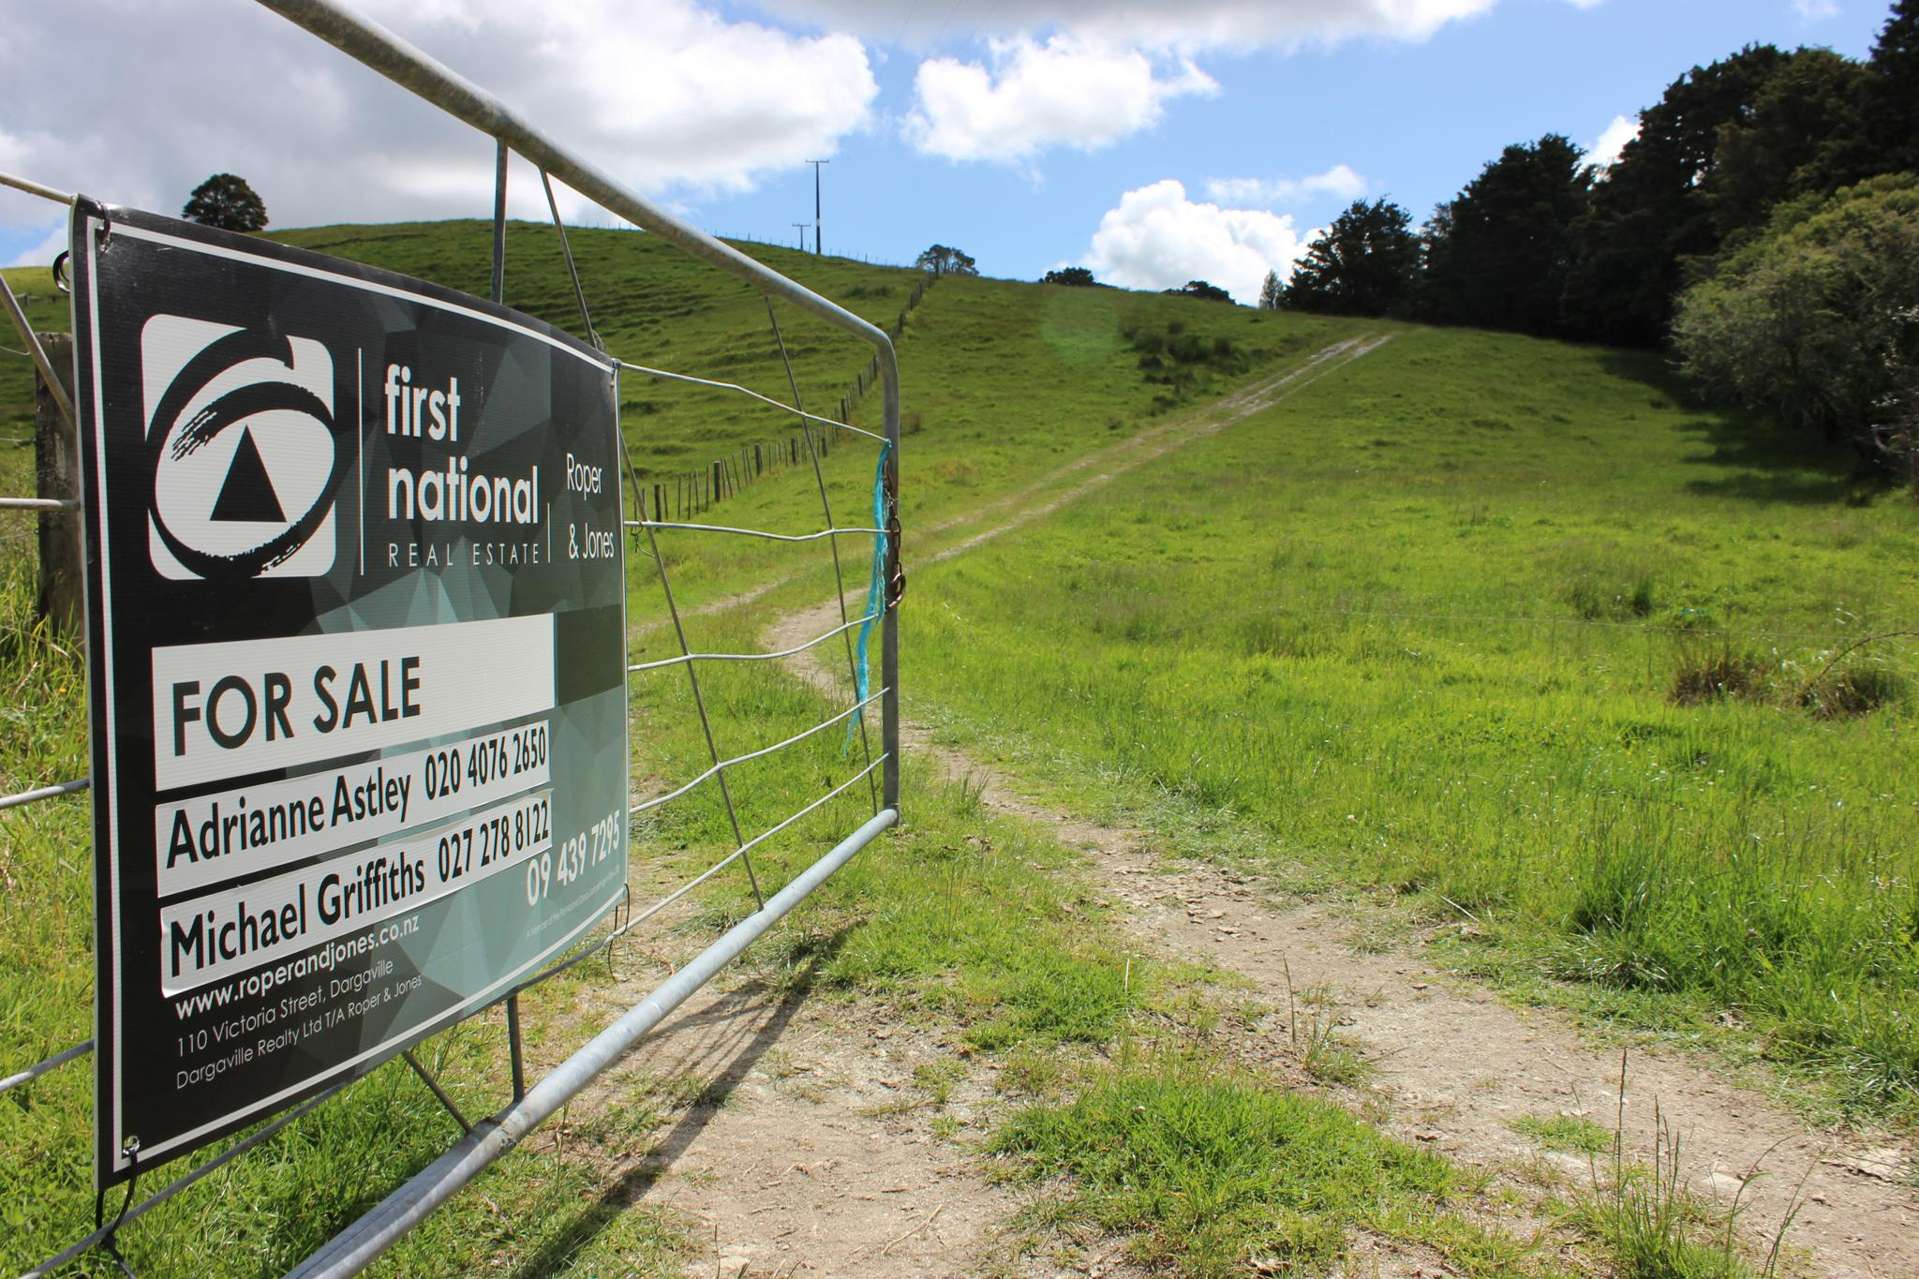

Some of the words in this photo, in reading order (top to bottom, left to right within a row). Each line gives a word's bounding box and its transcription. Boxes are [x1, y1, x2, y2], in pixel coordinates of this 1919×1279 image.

[385, 363, 460, 441] first
[388, 456, 539, 524] national
[566, 452, 602, 501] Roper
[388, 543, 454, 567] REAL
[473, 543, 539, 566] ESTATE
[568, 523, 579, 559] &
[582, 522, 614, 559] Jones
[173, 672, 295, 756] FOR
[313, 656, 420, 734] SALE
[166, 796, 325, 868] Adrianne
[331, 767, 411, 826] Astley
[425, 749, 461, 800] 020
[468, 736, 507, 787] 4076
[513, 726, 546, 774] 2650
[171, 883, 307, 977] Michael
[317, 852, 425, 925] Griffiths
[438, 828, 473, 882] 027
[480, 815, 510, 867] 278
[515, 800, 549, 851] 8122
[527, 852, 551, 906] 09
[557, 832, 586, 886] 439
[592, 810, 620, 867] 7295
[175, 914, 420, 1020] www.roperandjones.co.nz
[178, 1030, 208, 1057] 110
[212, 1007, 276, 1042] Victoria
[281, 989, 326, 1018] Street,
[330, 958, 394, 999] Dargaville
[176, 1047, 254, 1089] Dargaville
[258, 1029, 300, 1057] Realty
[303, 1017, 323, 1039] Ltd
[325, 1009, 346, 1029] T/A
[348, 995, 381, 1019] Roper
[383, 990, 392, 1003] &
[394, 974, 423, 999] Jones
